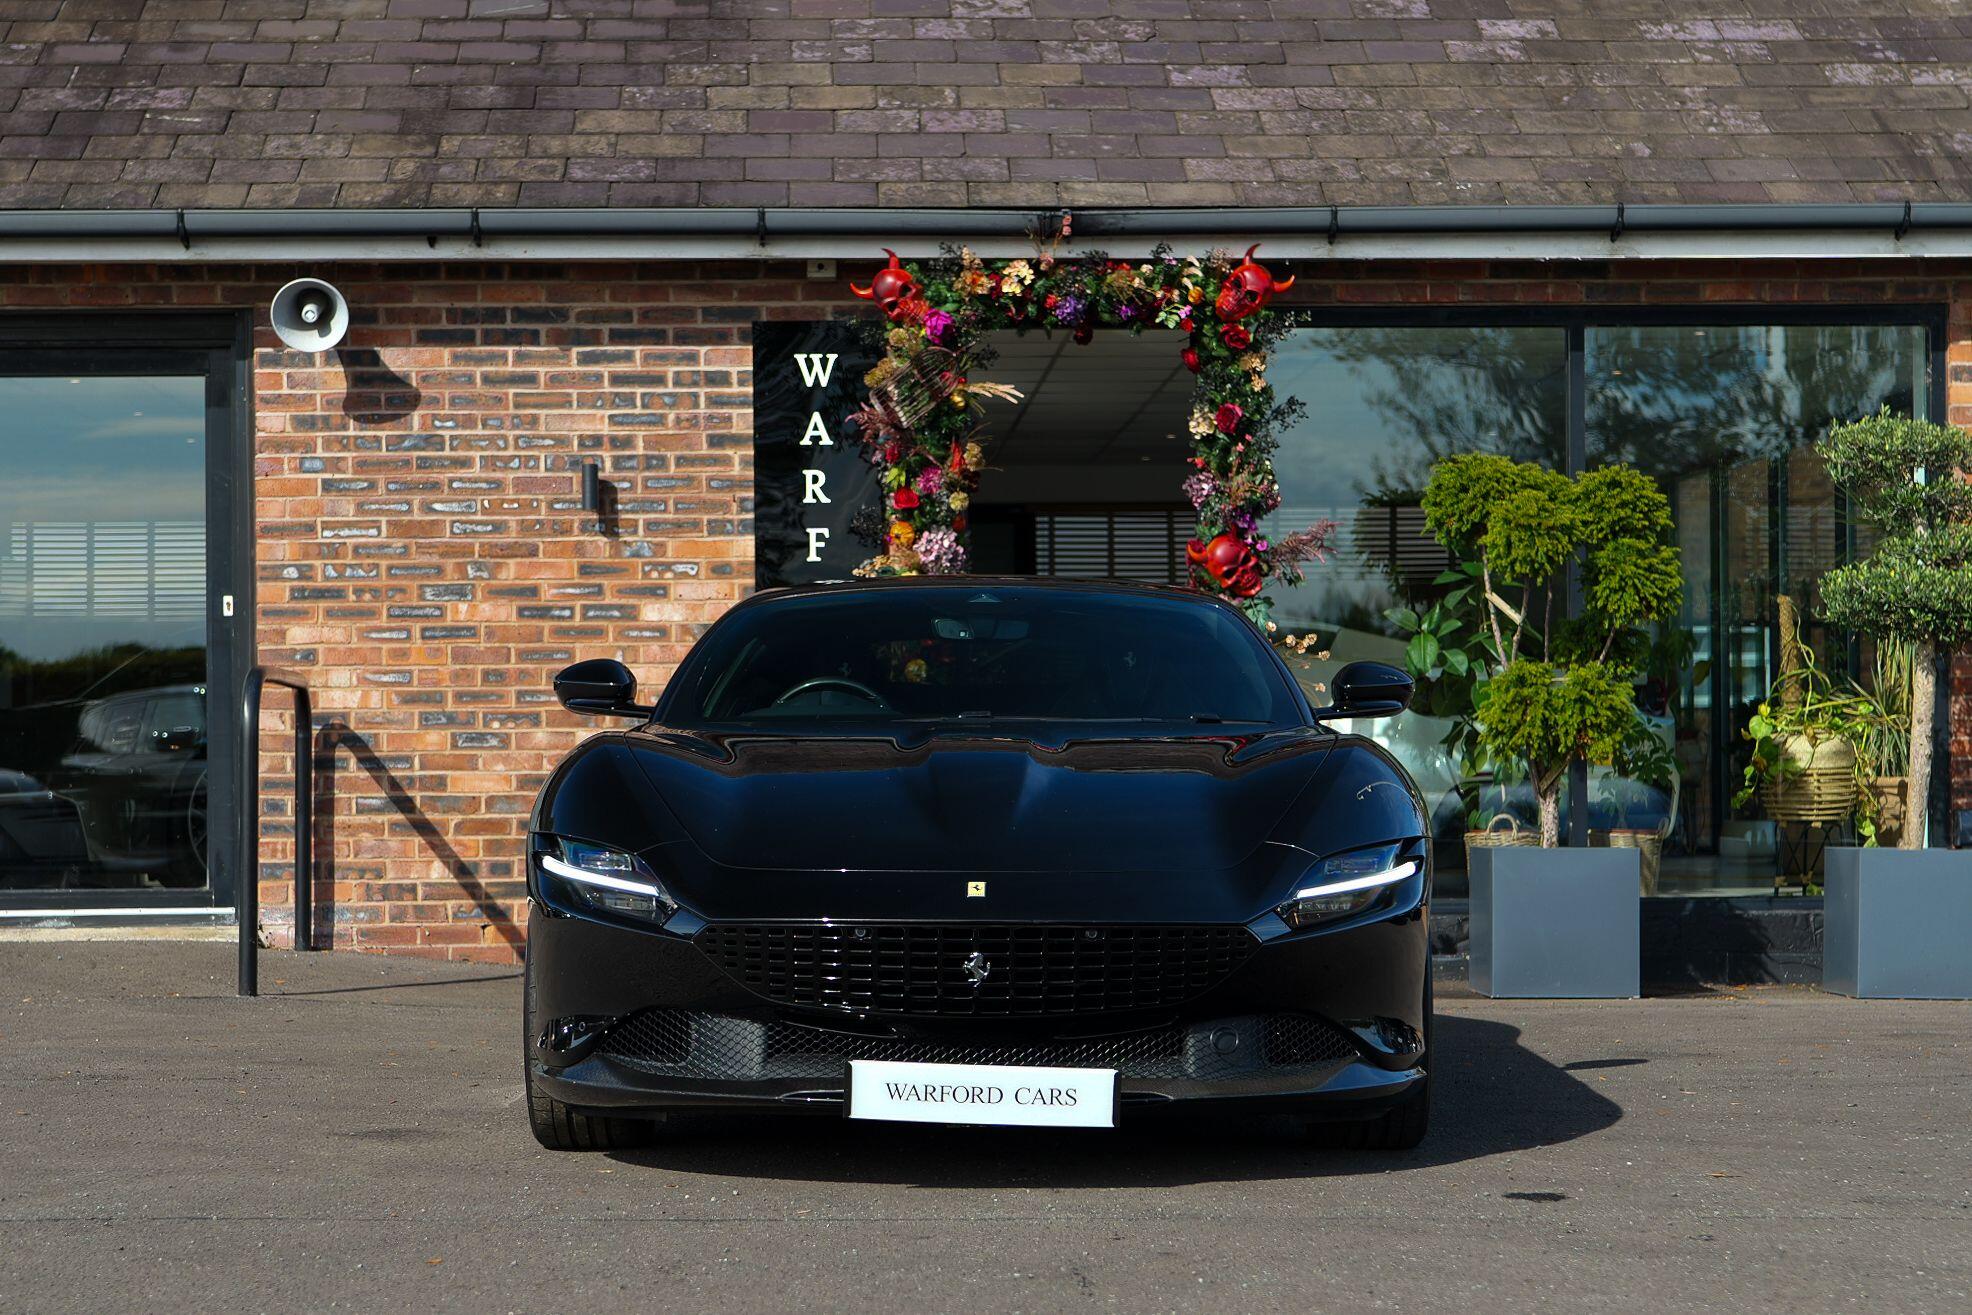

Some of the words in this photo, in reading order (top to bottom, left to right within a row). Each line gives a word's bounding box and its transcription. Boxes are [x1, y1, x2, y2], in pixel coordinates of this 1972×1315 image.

[793, 353, 839, 562] WARF
[885, 1082, 1004, 1105] WARFORD
[1014, 1086, 1078, 1107] CARS
